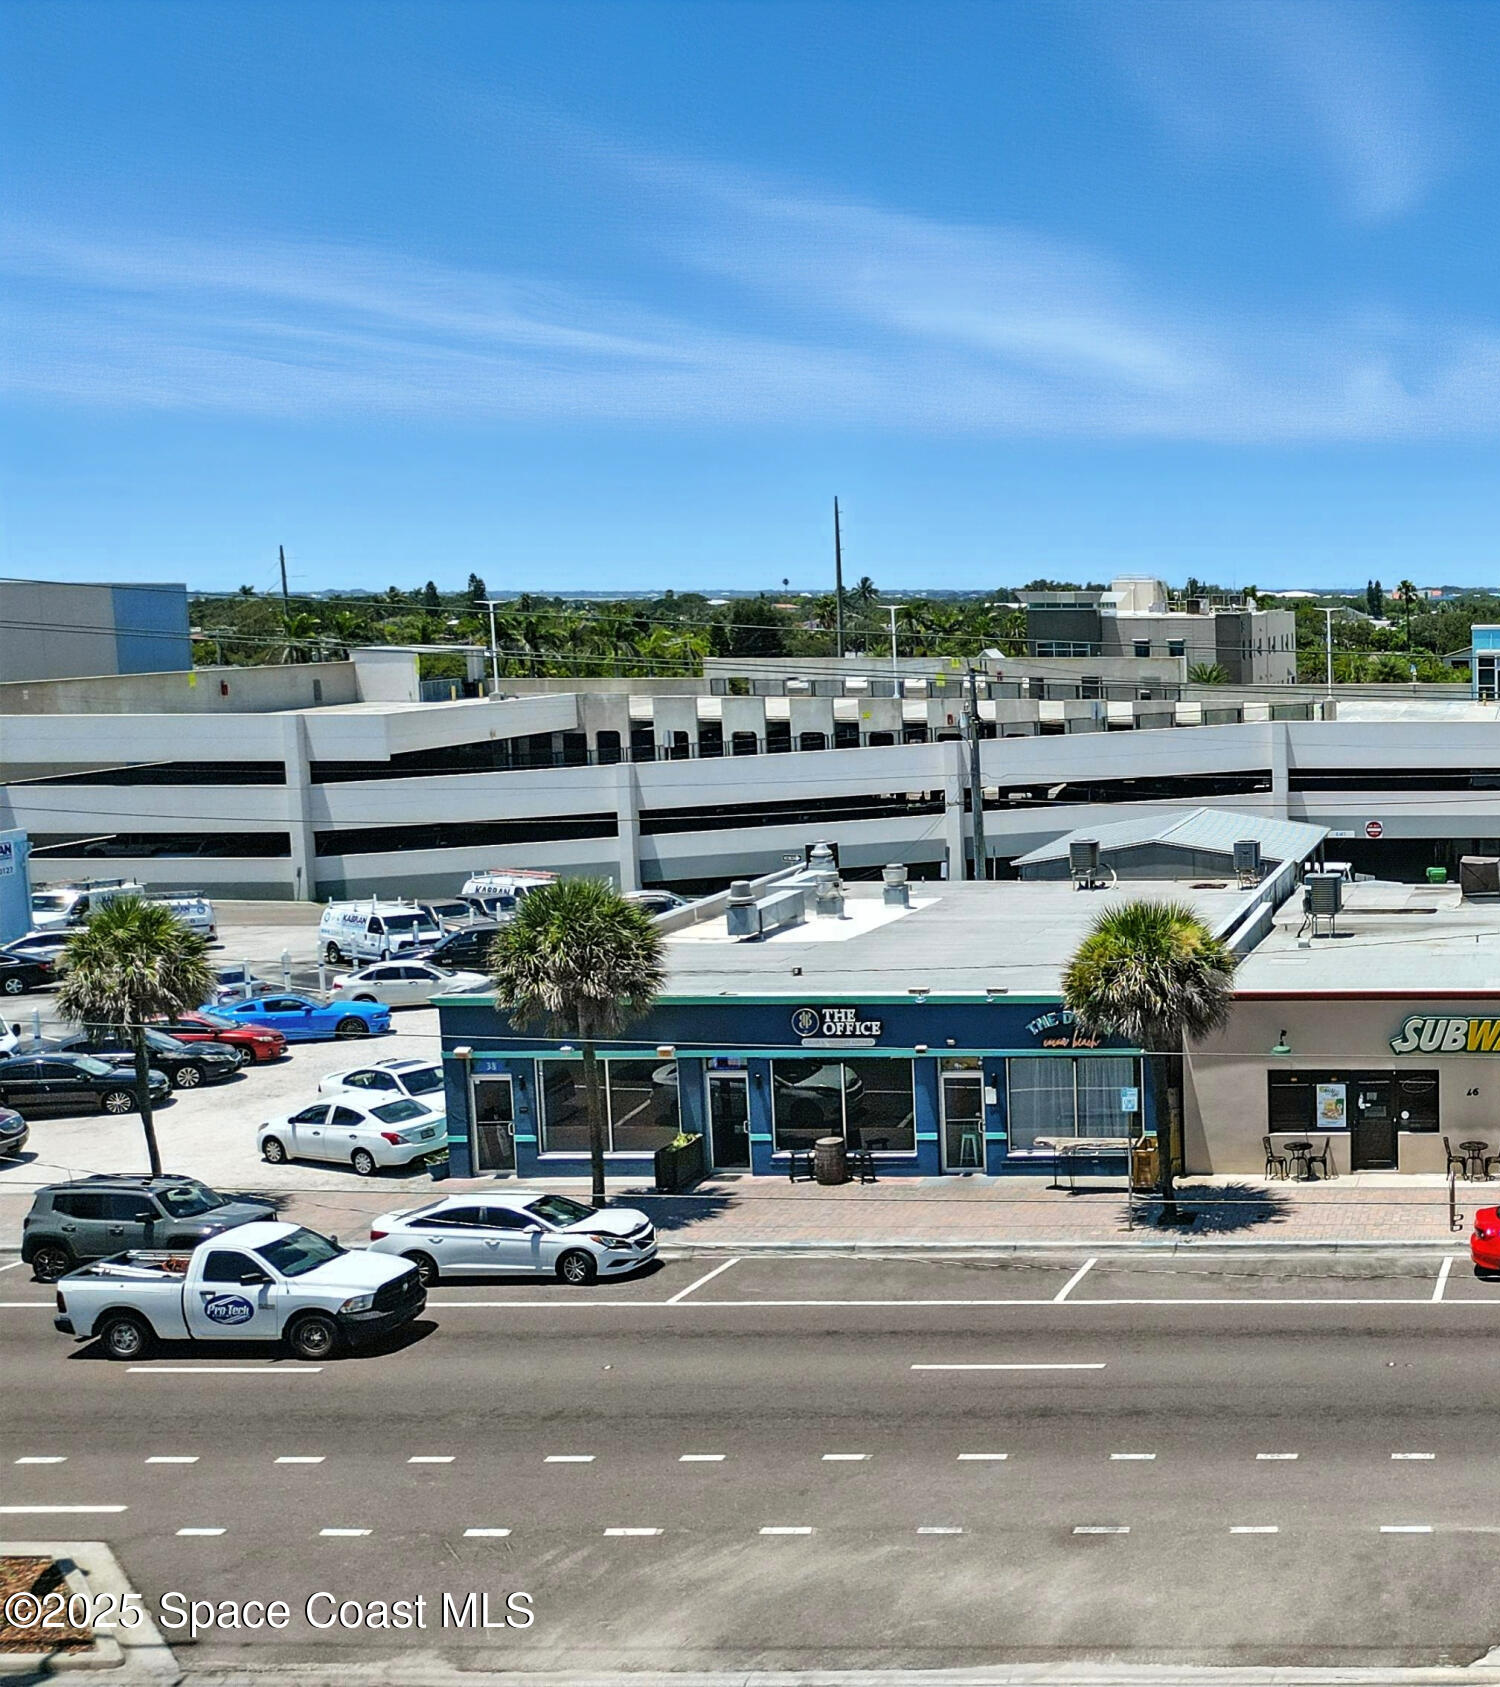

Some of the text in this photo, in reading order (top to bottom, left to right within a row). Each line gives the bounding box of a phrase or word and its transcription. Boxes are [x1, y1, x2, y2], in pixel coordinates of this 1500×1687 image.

[822, 1009, 856, 1022] THE
[823, 1022, 881, 1035] OFFICE
[1025, 1012, 1060, 1035] THE
